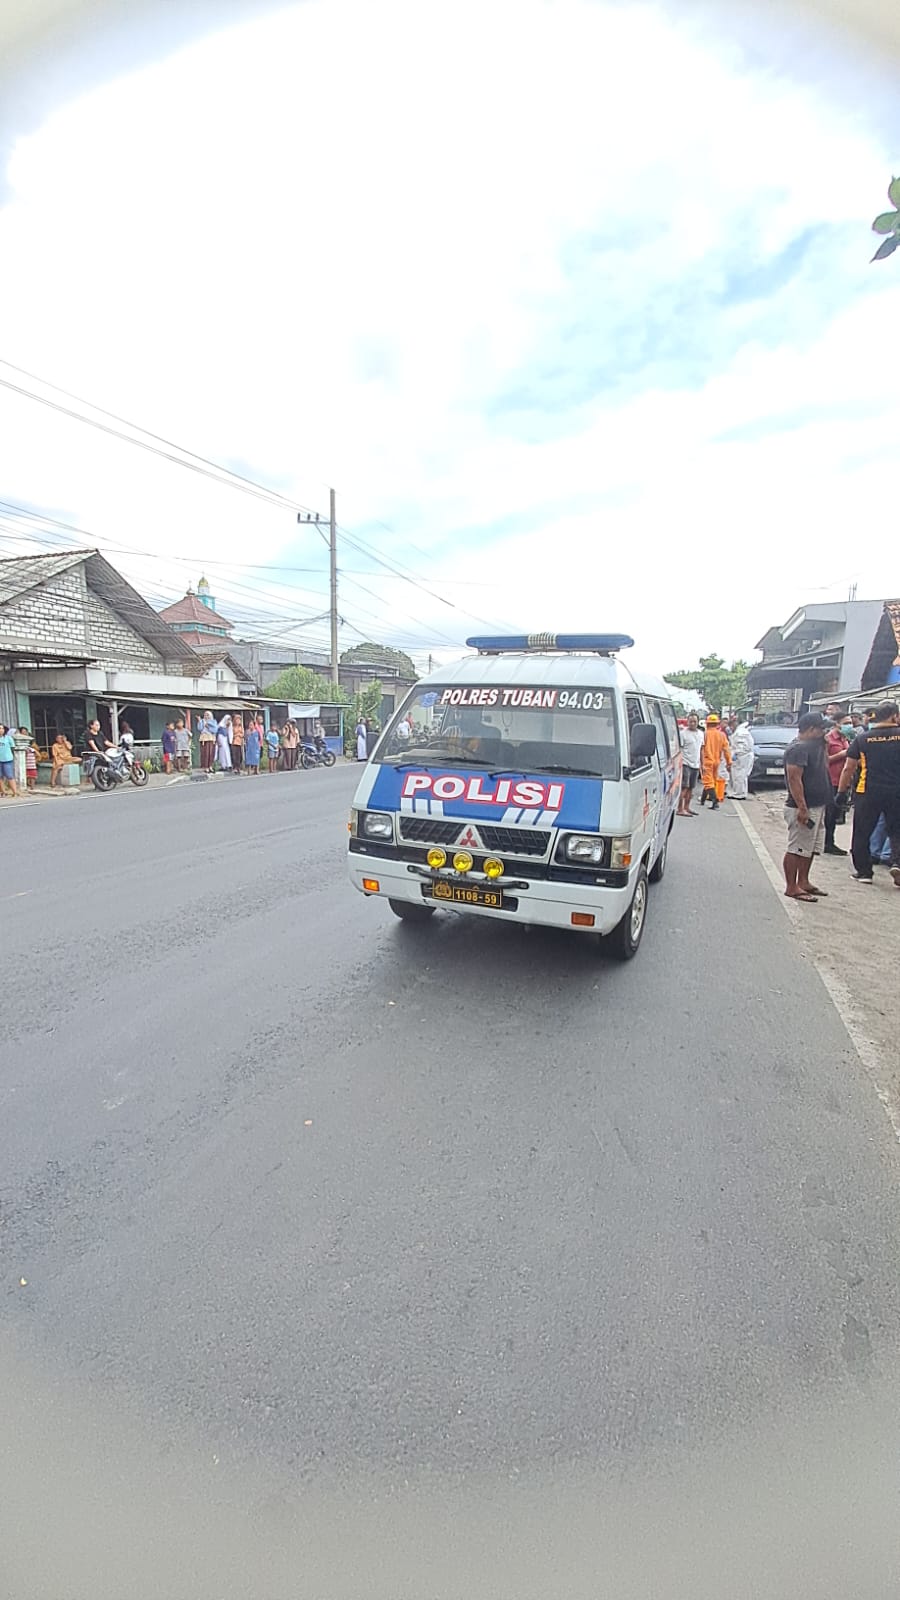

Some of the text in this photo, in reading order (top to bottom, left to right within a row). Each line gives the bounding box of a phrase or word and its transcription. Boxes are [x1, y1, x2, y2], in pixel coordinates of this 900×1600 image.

[440, 688, 604, 710] POLRES TUBAN 94.03
[403, 773, 564, 810] POLISI
